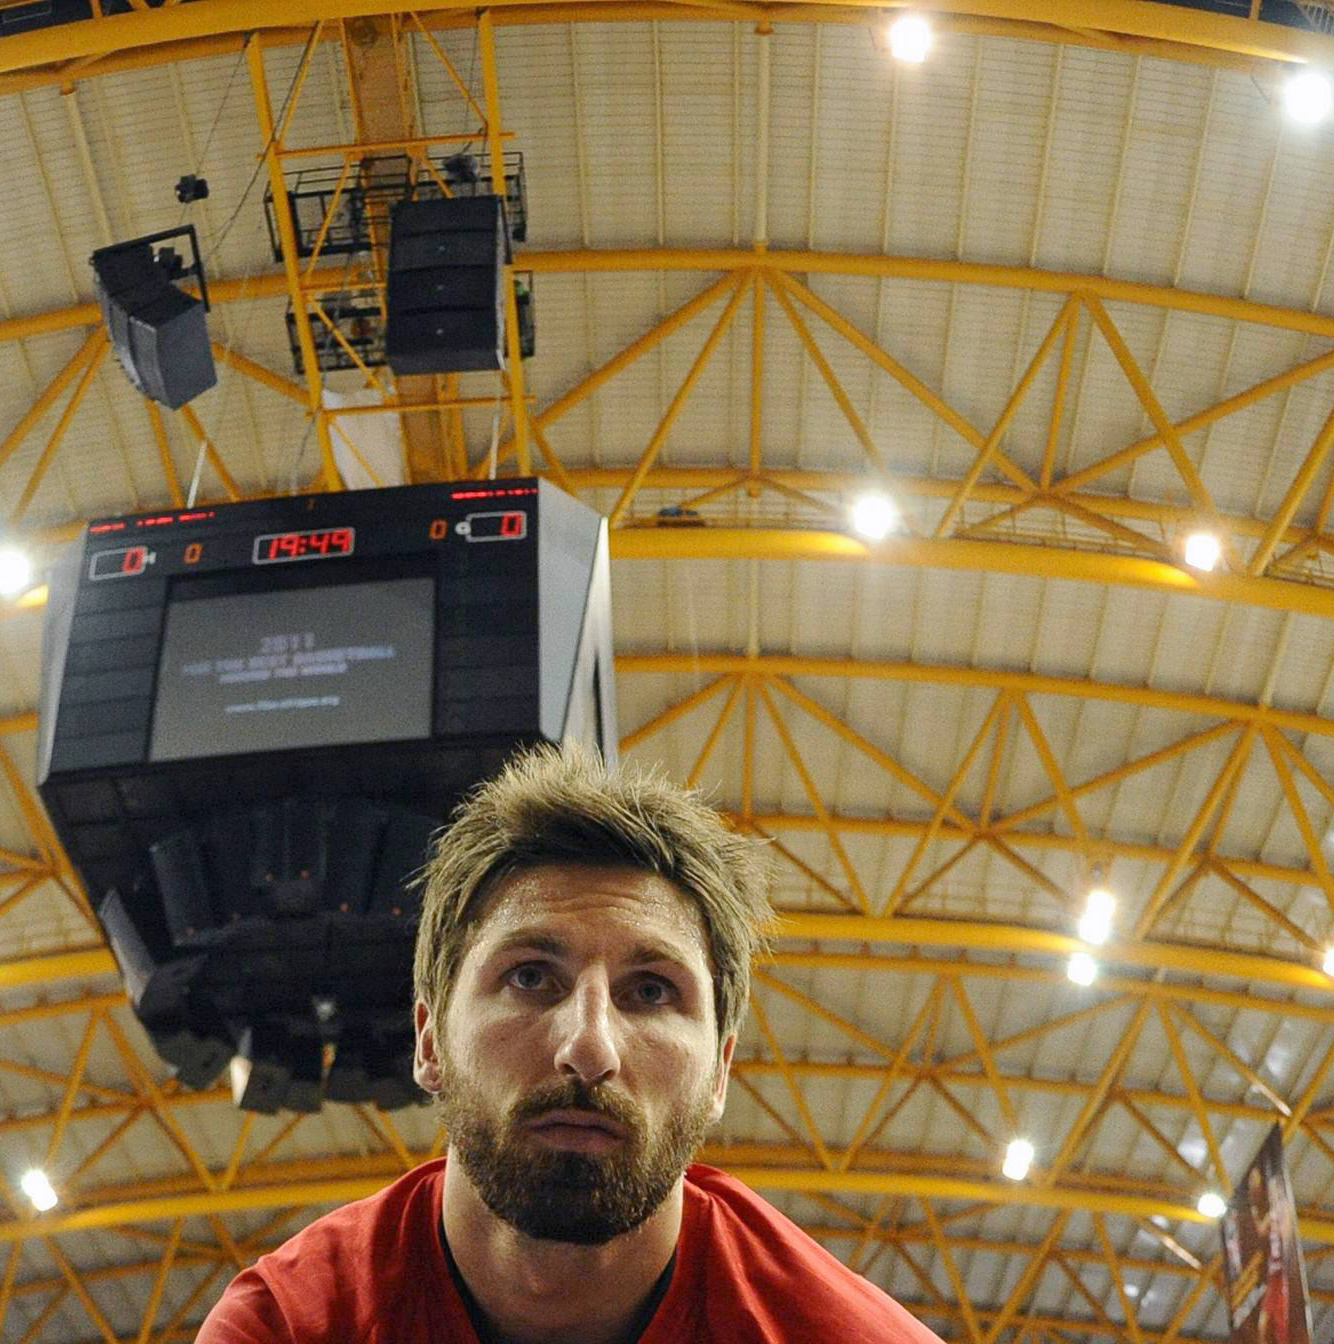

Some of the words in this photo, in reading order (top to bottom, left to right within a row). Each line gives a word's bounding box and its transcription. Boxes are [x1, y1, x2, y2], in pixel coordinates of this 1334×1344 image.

[429, 519, 448, 539] 0
[501, 511, 524, 537] 0
[184, 543, 203, 564] 0
[268, 528, 352, 561] 19:49
[122, 546, 146, 573] 0
